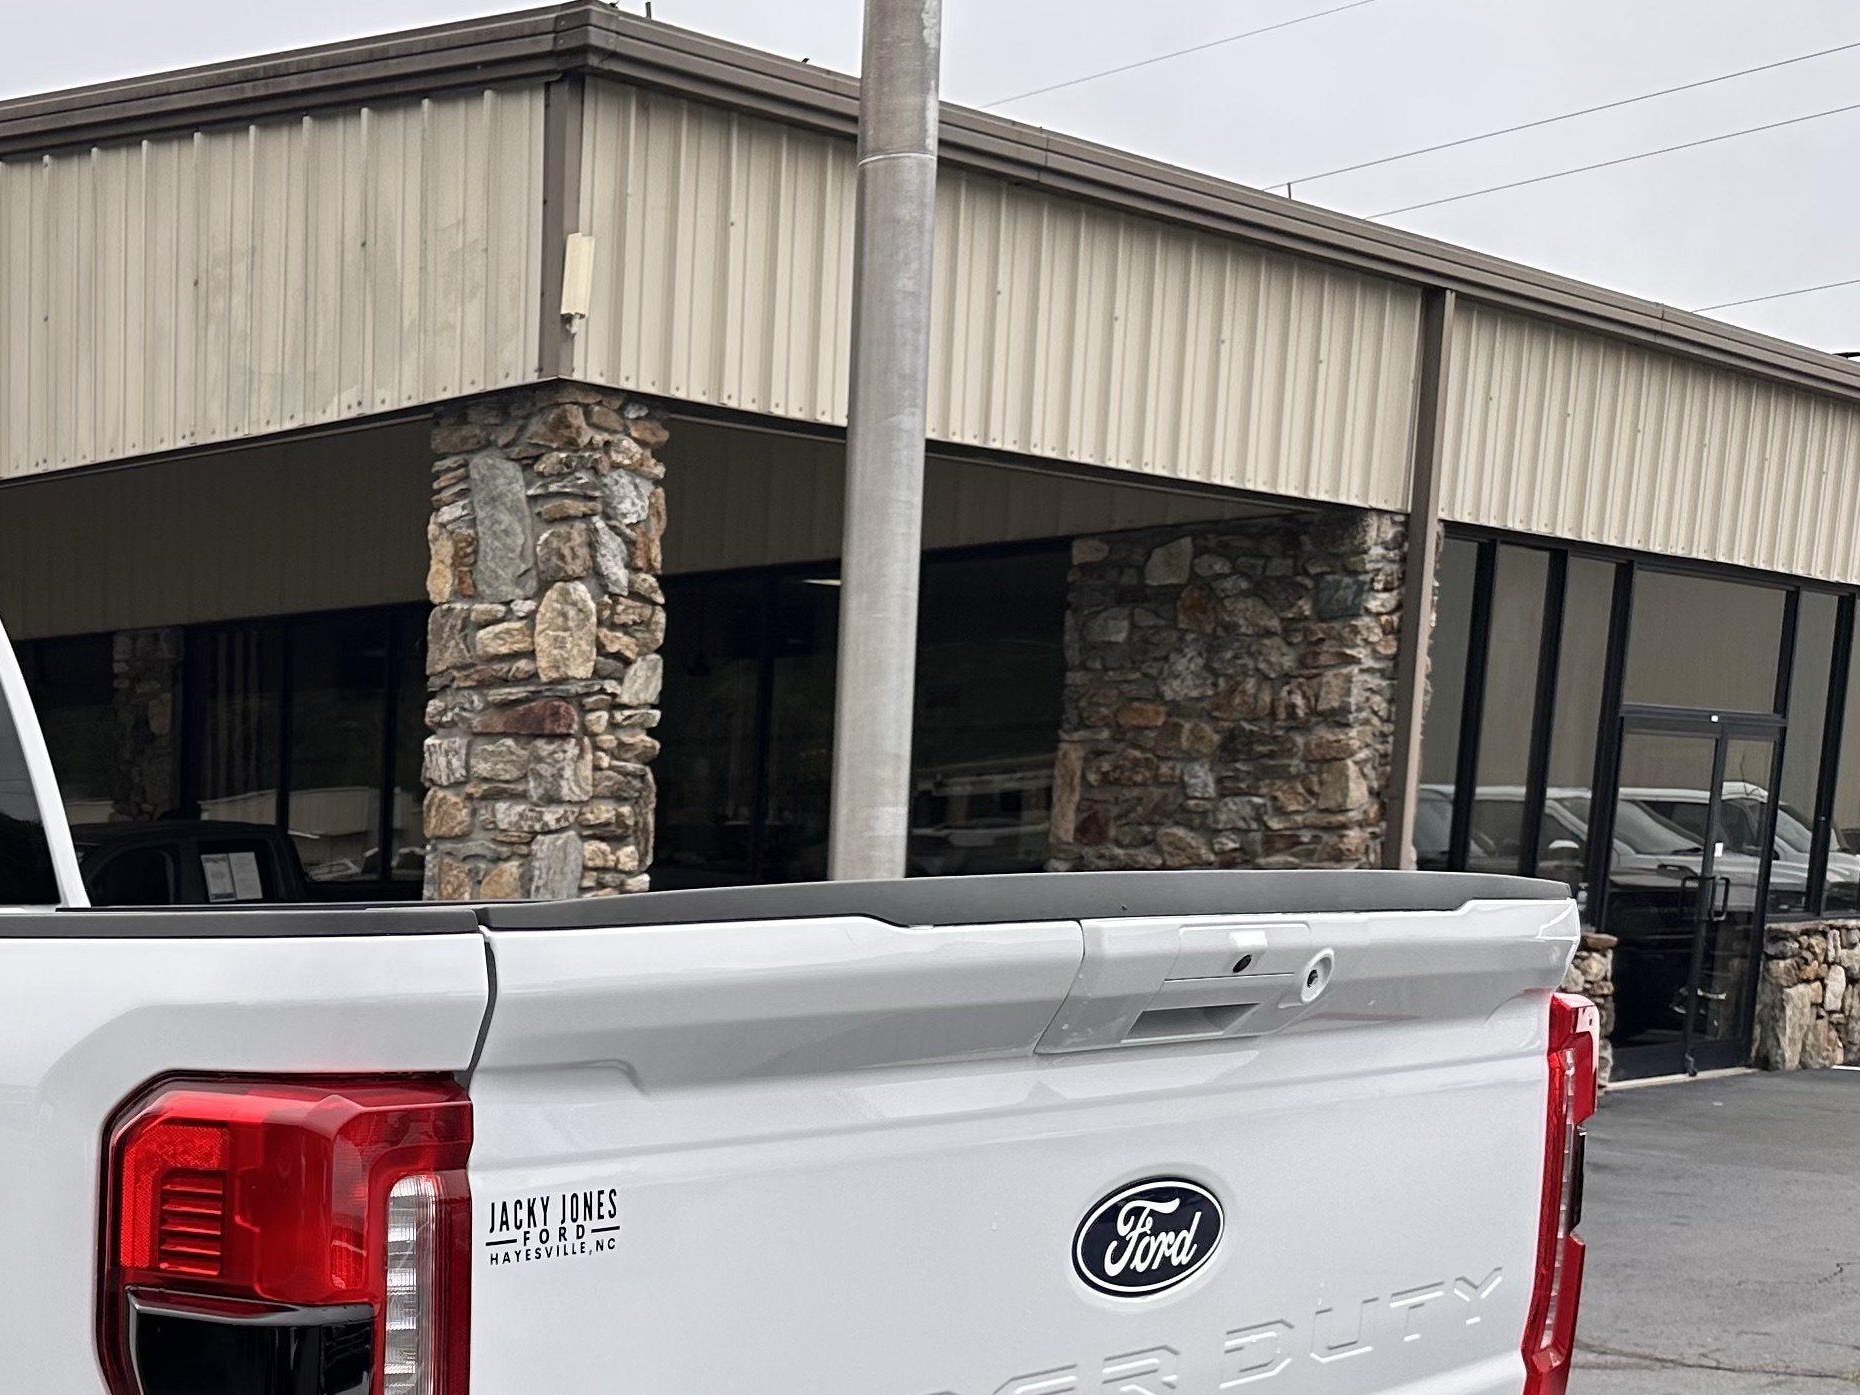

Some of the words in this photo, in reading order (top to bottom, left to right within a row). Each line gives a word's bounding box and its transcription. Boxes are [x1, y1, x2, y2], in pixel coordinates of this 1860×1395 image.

[490, 1196, 550, 1234] JACKY
[560, 1188, 618, 1226] JONES
[523, 1224, 586, 1247] FORD
[1103, 1199, 1201, 1277] Ford
[1219, 1266, 1505, 1391] DUTY
